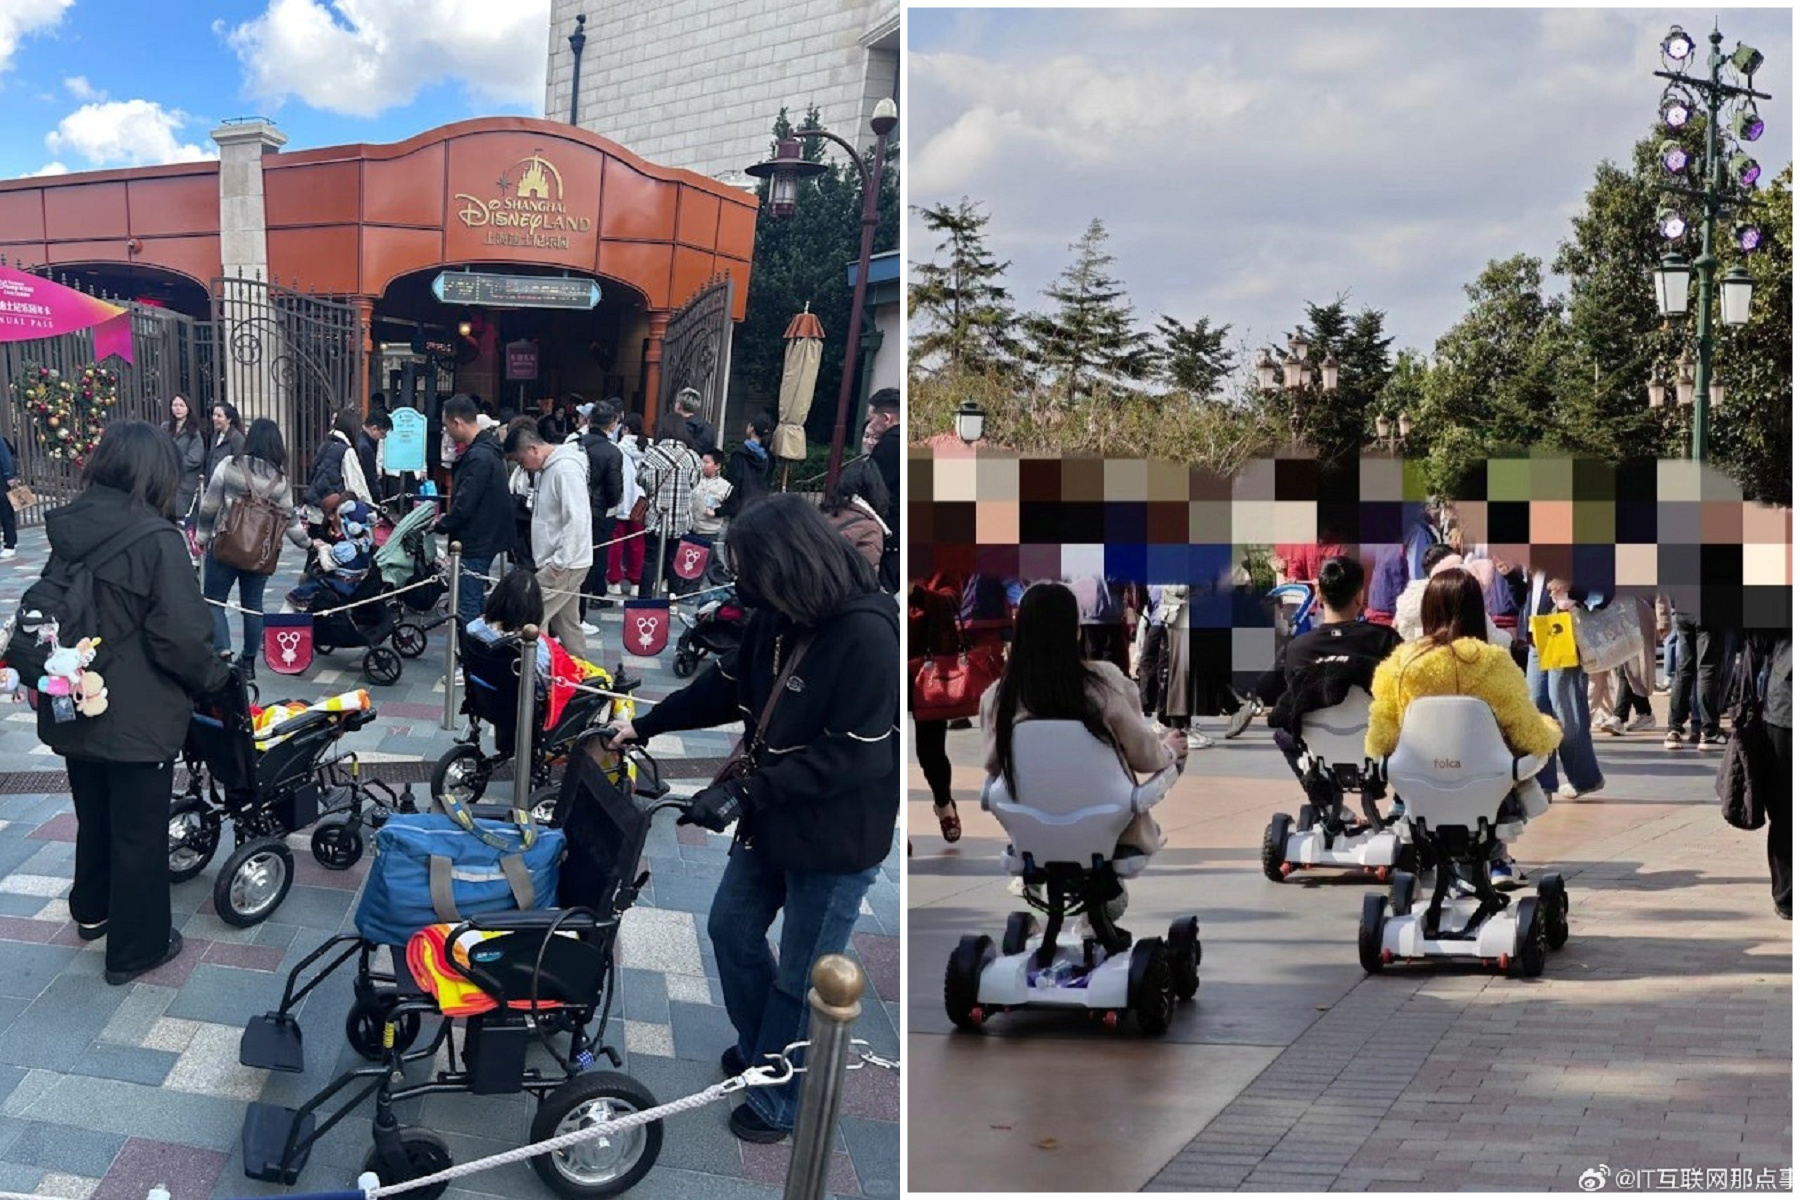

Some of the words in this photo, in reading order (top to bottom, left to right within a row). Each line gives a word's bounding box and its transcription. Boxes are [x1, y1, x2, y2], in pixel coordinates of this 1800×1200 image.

[504, 198, 566, 214] SHANGHAI
[30, 319, 54, 329] PASS
[1433, 757, 1461, 769] folca
